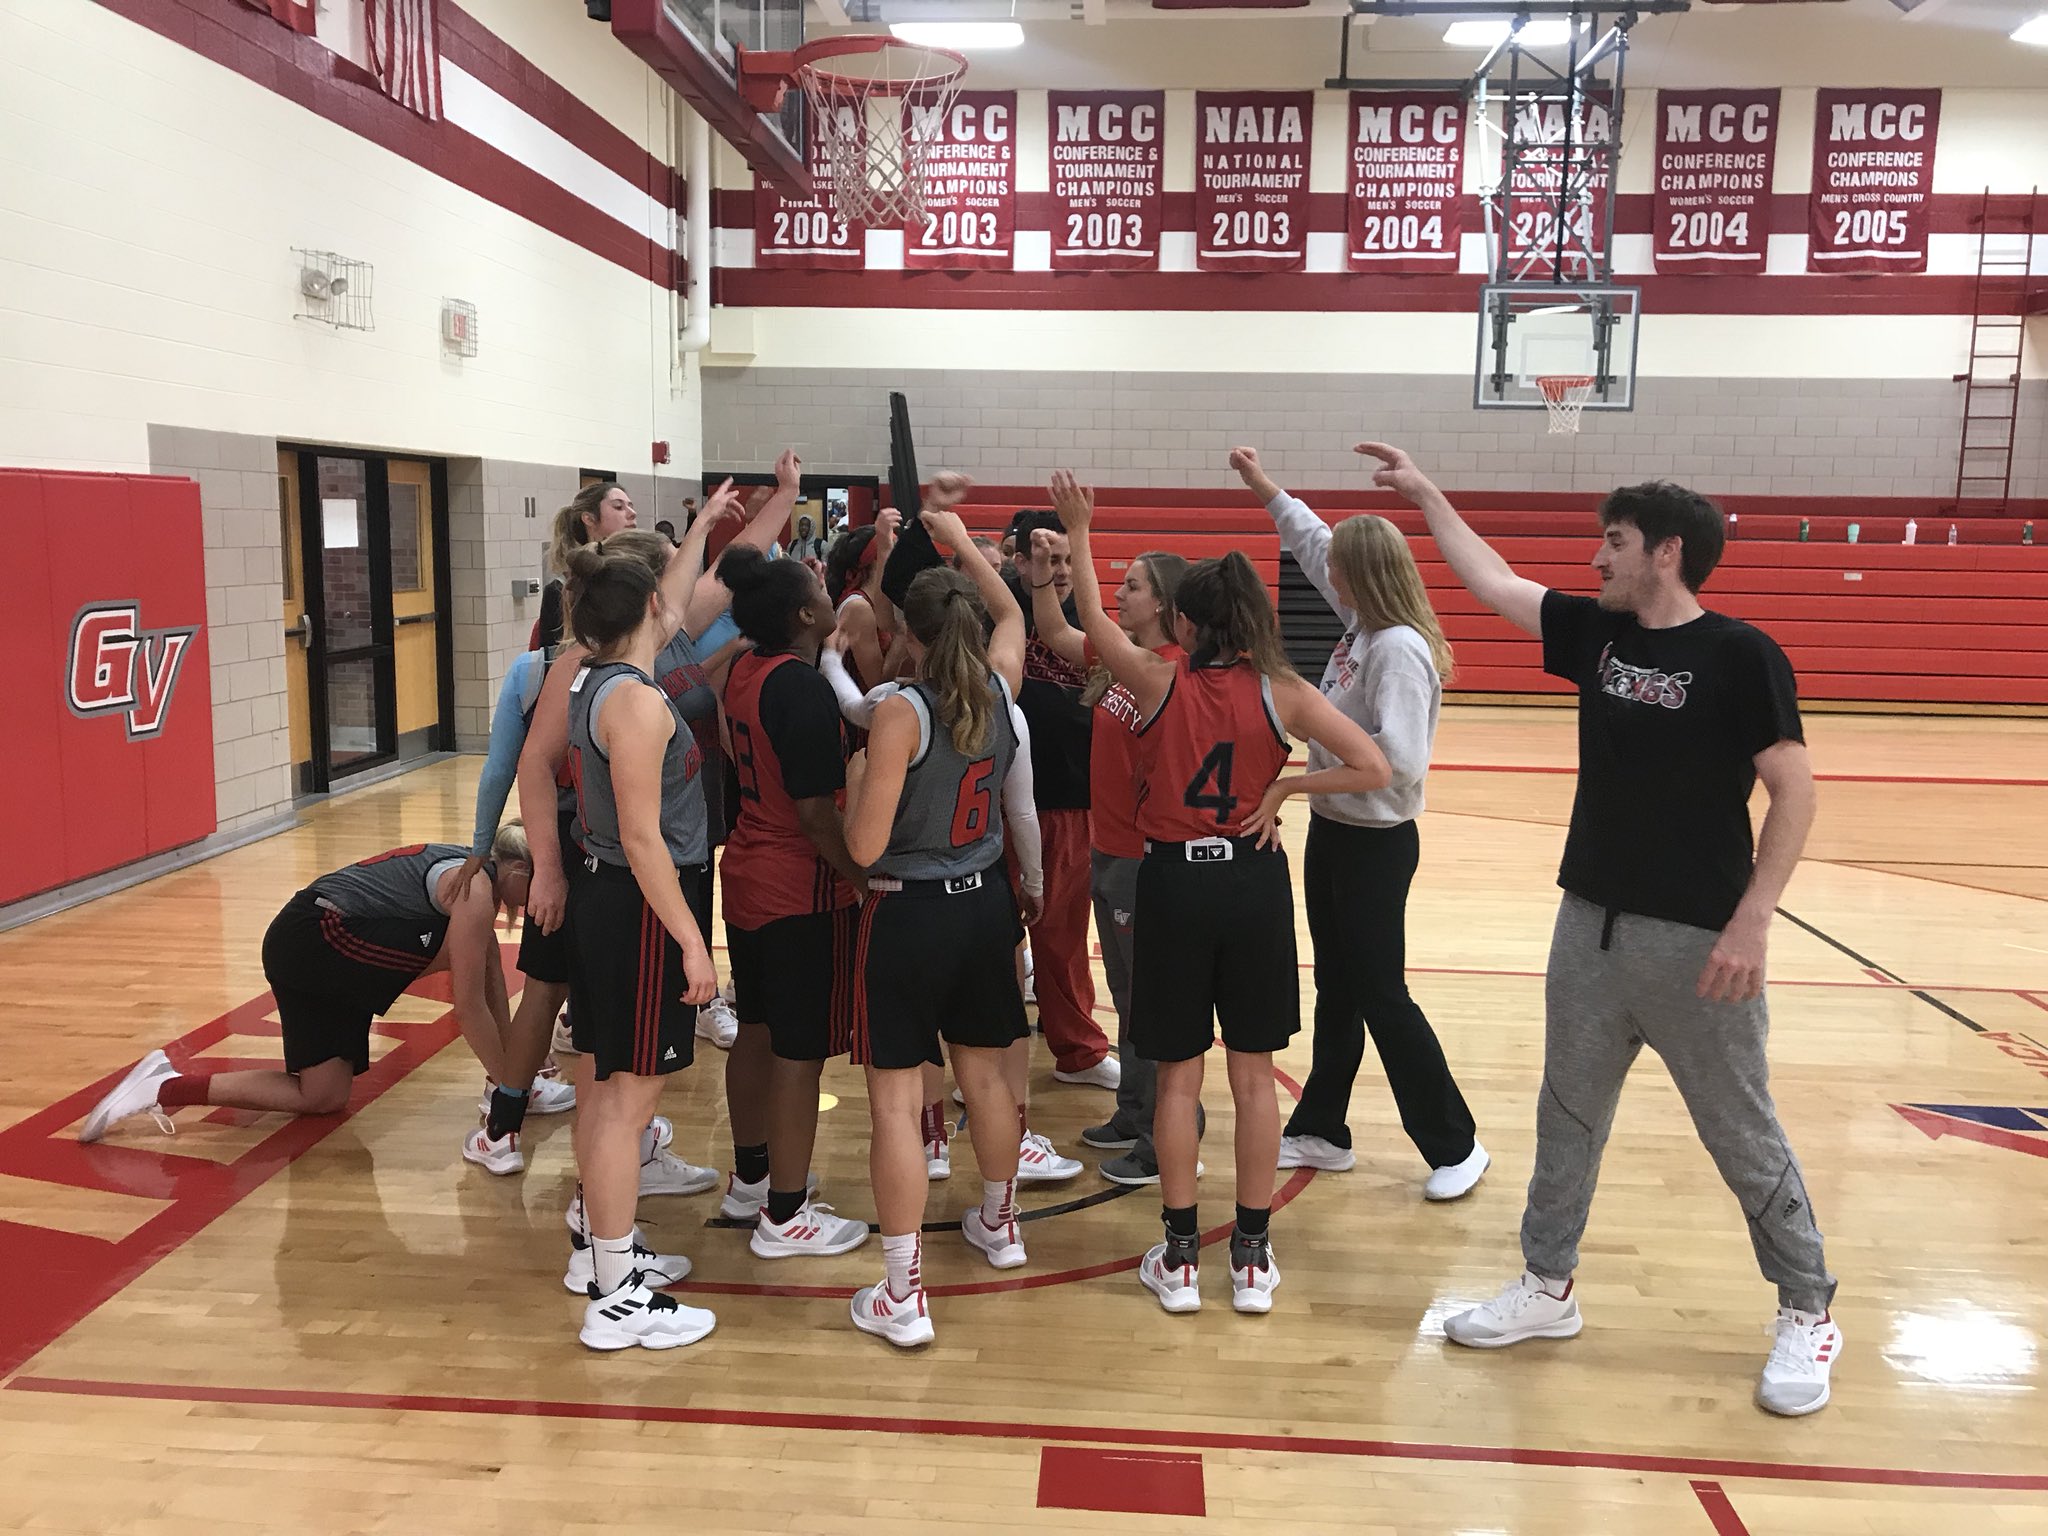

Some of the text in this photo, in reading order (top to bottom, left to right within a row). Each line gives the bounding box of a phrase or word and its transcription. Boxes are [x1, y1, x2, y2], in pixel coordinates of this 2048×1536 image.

[910, 104, 1008, 142] MCC
[1057, 103, 1156, 142] MCC
[1205, 106, 1304, 143] NAIA
[1357, 104, 1459, 144] MCC
[1665, 103, 1769, 143] MCC
[1829, 103, 1926, 141] MCC
[1001, 145, 1011, 160] &
[1053, 145, 1159, 161] CONFERENCE &
[1354, 146, 1459, 162] CONFERENCE &
[1827, 151, 1923, 168] CONFERENCE
[1203, 153, 1303, 170] NATIONAL
[1662, 153, 1766, 170] CONFERENCE
[1056, 163, 1155, 179] TOURNAMENT
[1356, 163, 1456, 179] TOURNAMENT
[1830, 171, 1919, 187] CHAMPIONS
[911, 179, 1008, 196] HAMPIONS
[1056, 180, 1155, 197] CHAMPIONS
[1203, 172, 1302, 189] TOURNAMENT
[1661, 173, 1764, 190] CHAMPIONS
[1216, 192, 1289, 204] MEN'S SOCCER
[1355, 182, 1456, 198] CHAMPIONS
[1820, 192, 1925, 203] MEN'S CROSS COUNTRY
[965, 197, 1000, 208] SOCCER
[1069, 197, 1142, 208] MEN'S SOCCER
[1367, 199, 1442, 210] MEN'S SOCCER
[1669, 193, 1754, 206] WOMEN'S SOCCER
[773, 211, 849, 246] 2003
[921, 211, 997, 246] 2003
[1067, 212, 1143, 247] 2003
[1212, 210, 1290, 246] 2003
[1364, 215, 1443, 250] 2004
[1669, 211, 1749, 247] 2004
[1833, 209, 1908, 246] 2005
[64, 599, 201, 743] GV
[1184, 741, 1238, 825] 4
[949, 754, 996, 849] 6
